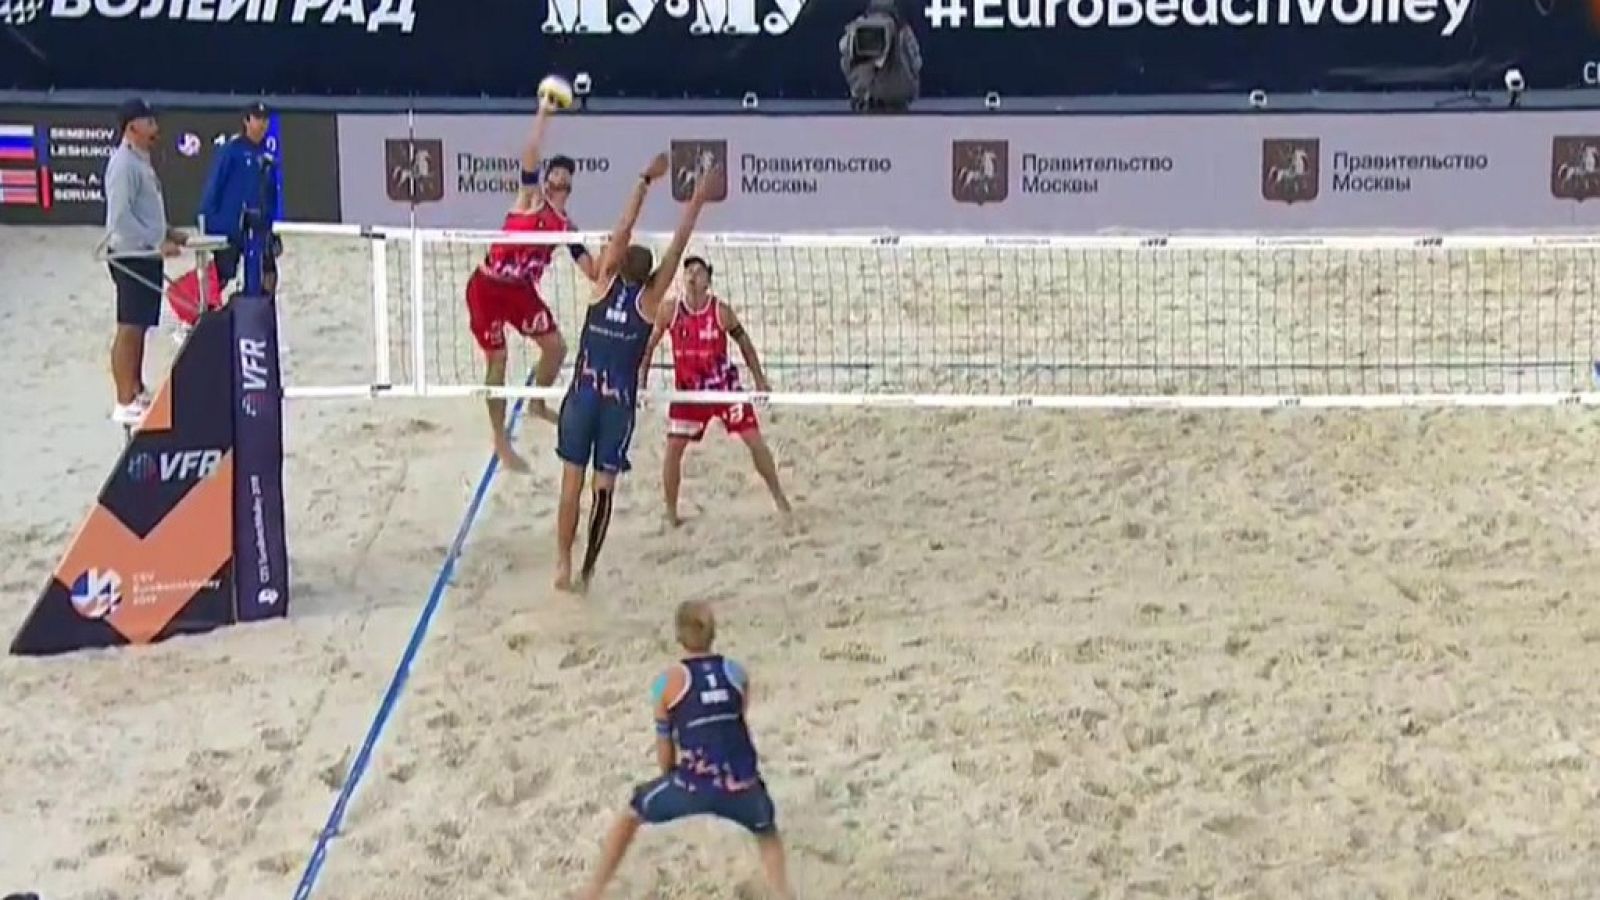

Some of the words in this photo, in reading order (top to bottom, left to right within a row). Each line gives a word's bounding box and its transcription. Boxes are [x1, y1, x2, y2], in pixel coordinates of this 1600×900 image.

[740, 153, 892, 174] Правительство
[1022, 152, 1173, 174] Правительство
[1333, 151, 1488, 173] Правительство
[740, 174, 818, 193] Москвы
[1022, 174, 1099, 193] Москвы
[1333, 173, 1411, 192] Москвы
[241, 338, 267, 389] VFR
[160, 449, 222, 481] VFR
